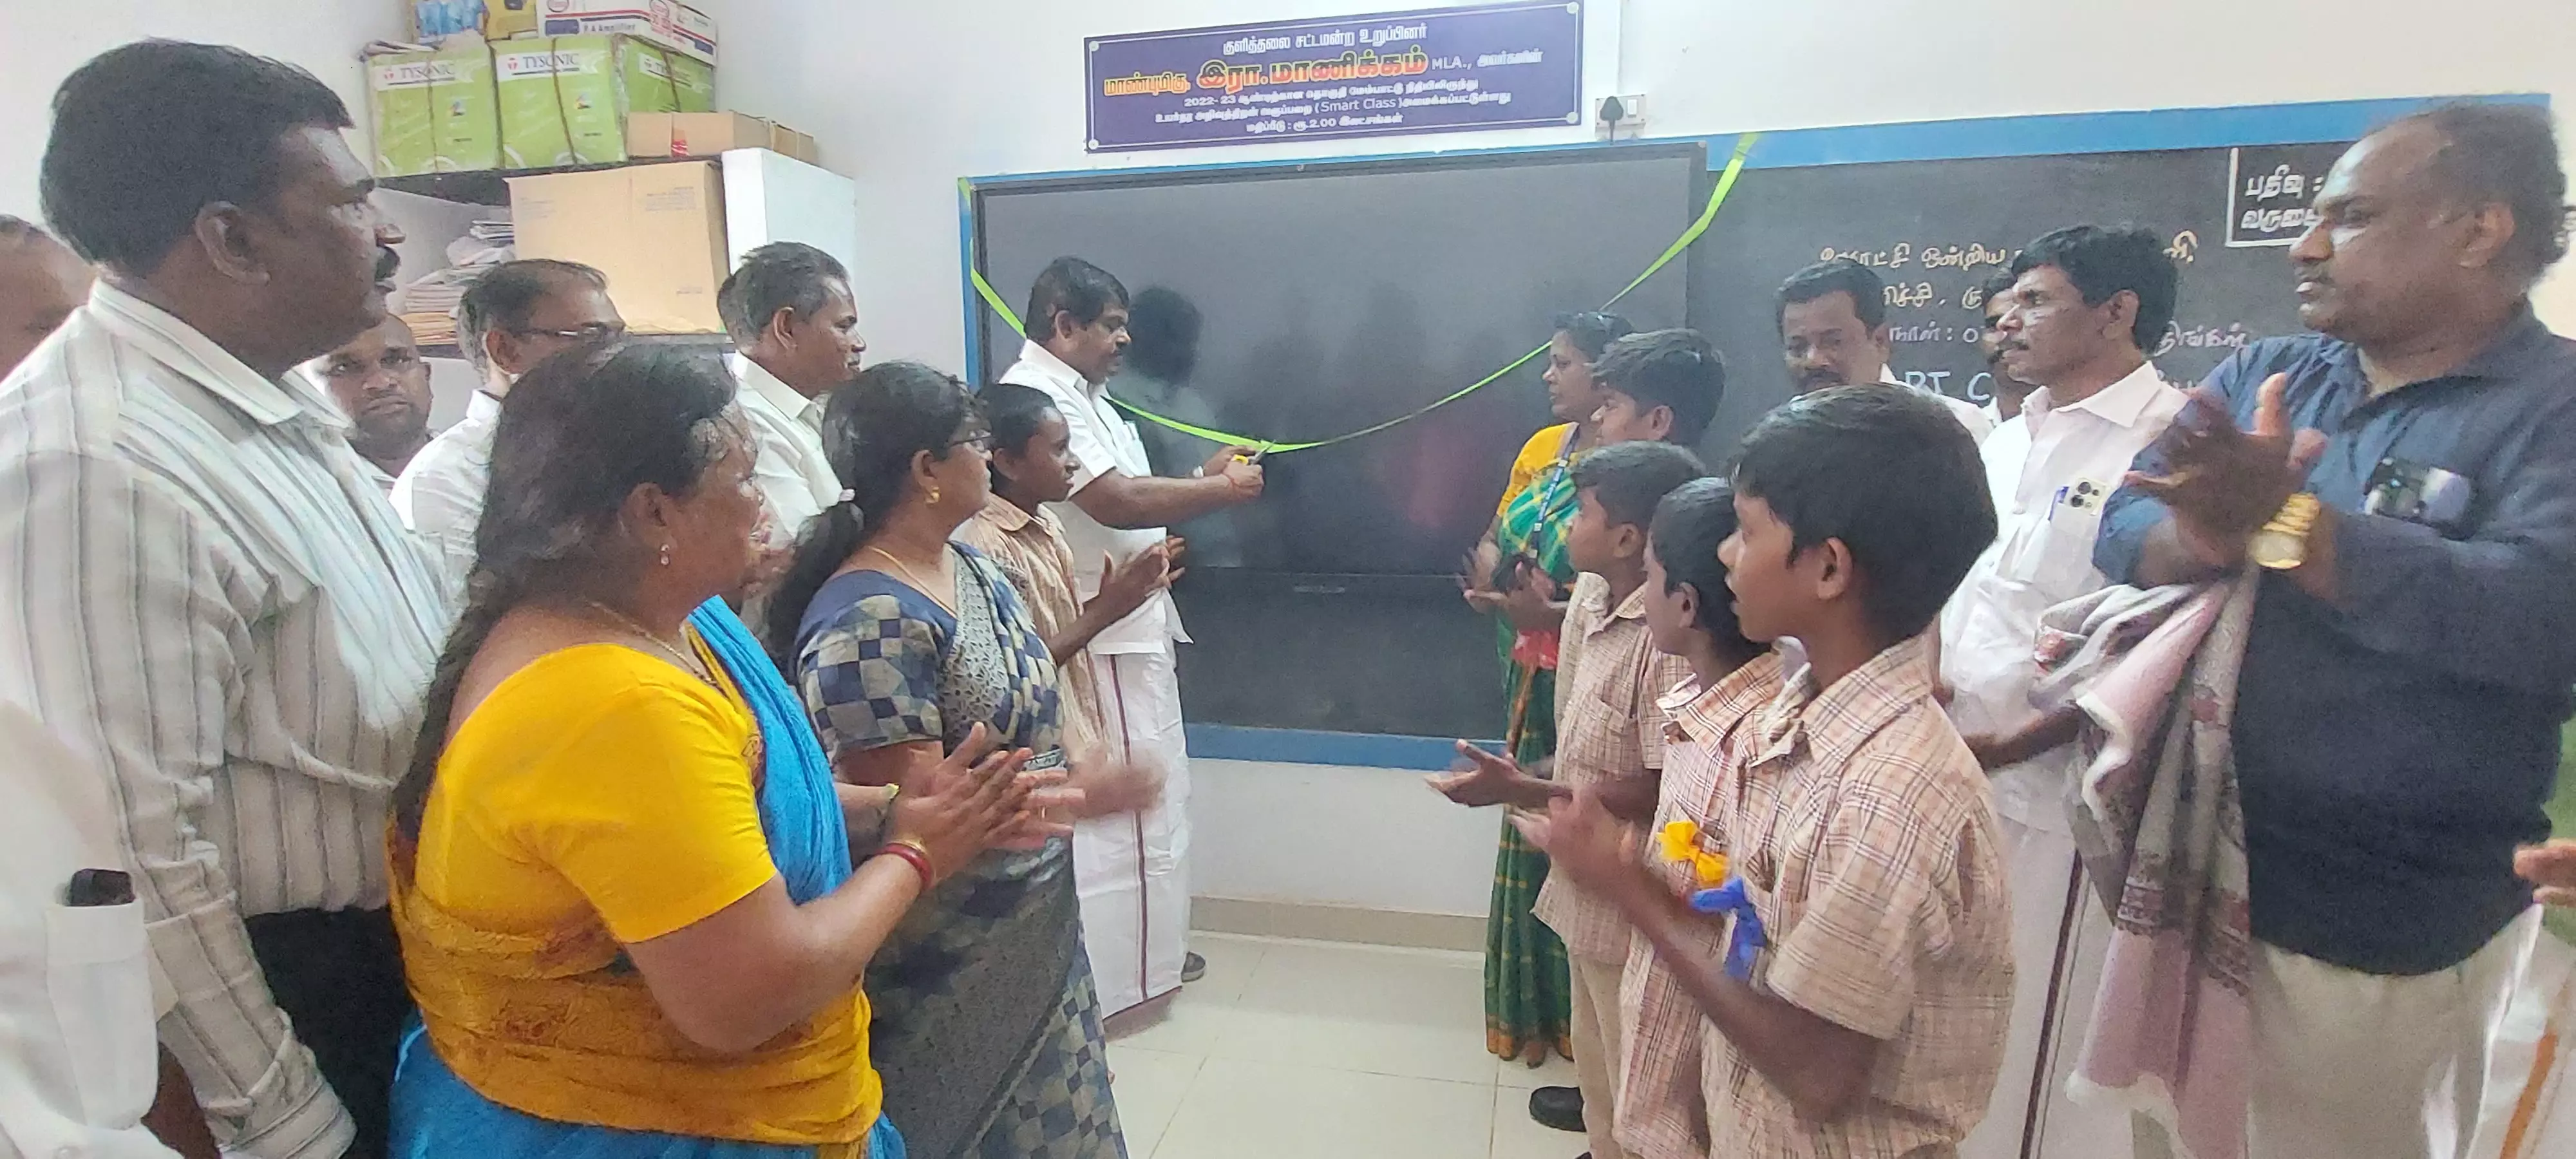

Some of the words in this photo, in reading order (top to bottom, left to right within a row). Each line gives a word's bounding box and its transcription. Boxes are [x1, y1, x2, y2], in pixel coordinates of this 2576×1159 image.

[1223, 35, 1291, 56] குளித்தலை
[1295, 28, 1355, 49] சட்டமன்ற
[1359, 23, 1428, 47] உறுப்பினர்
